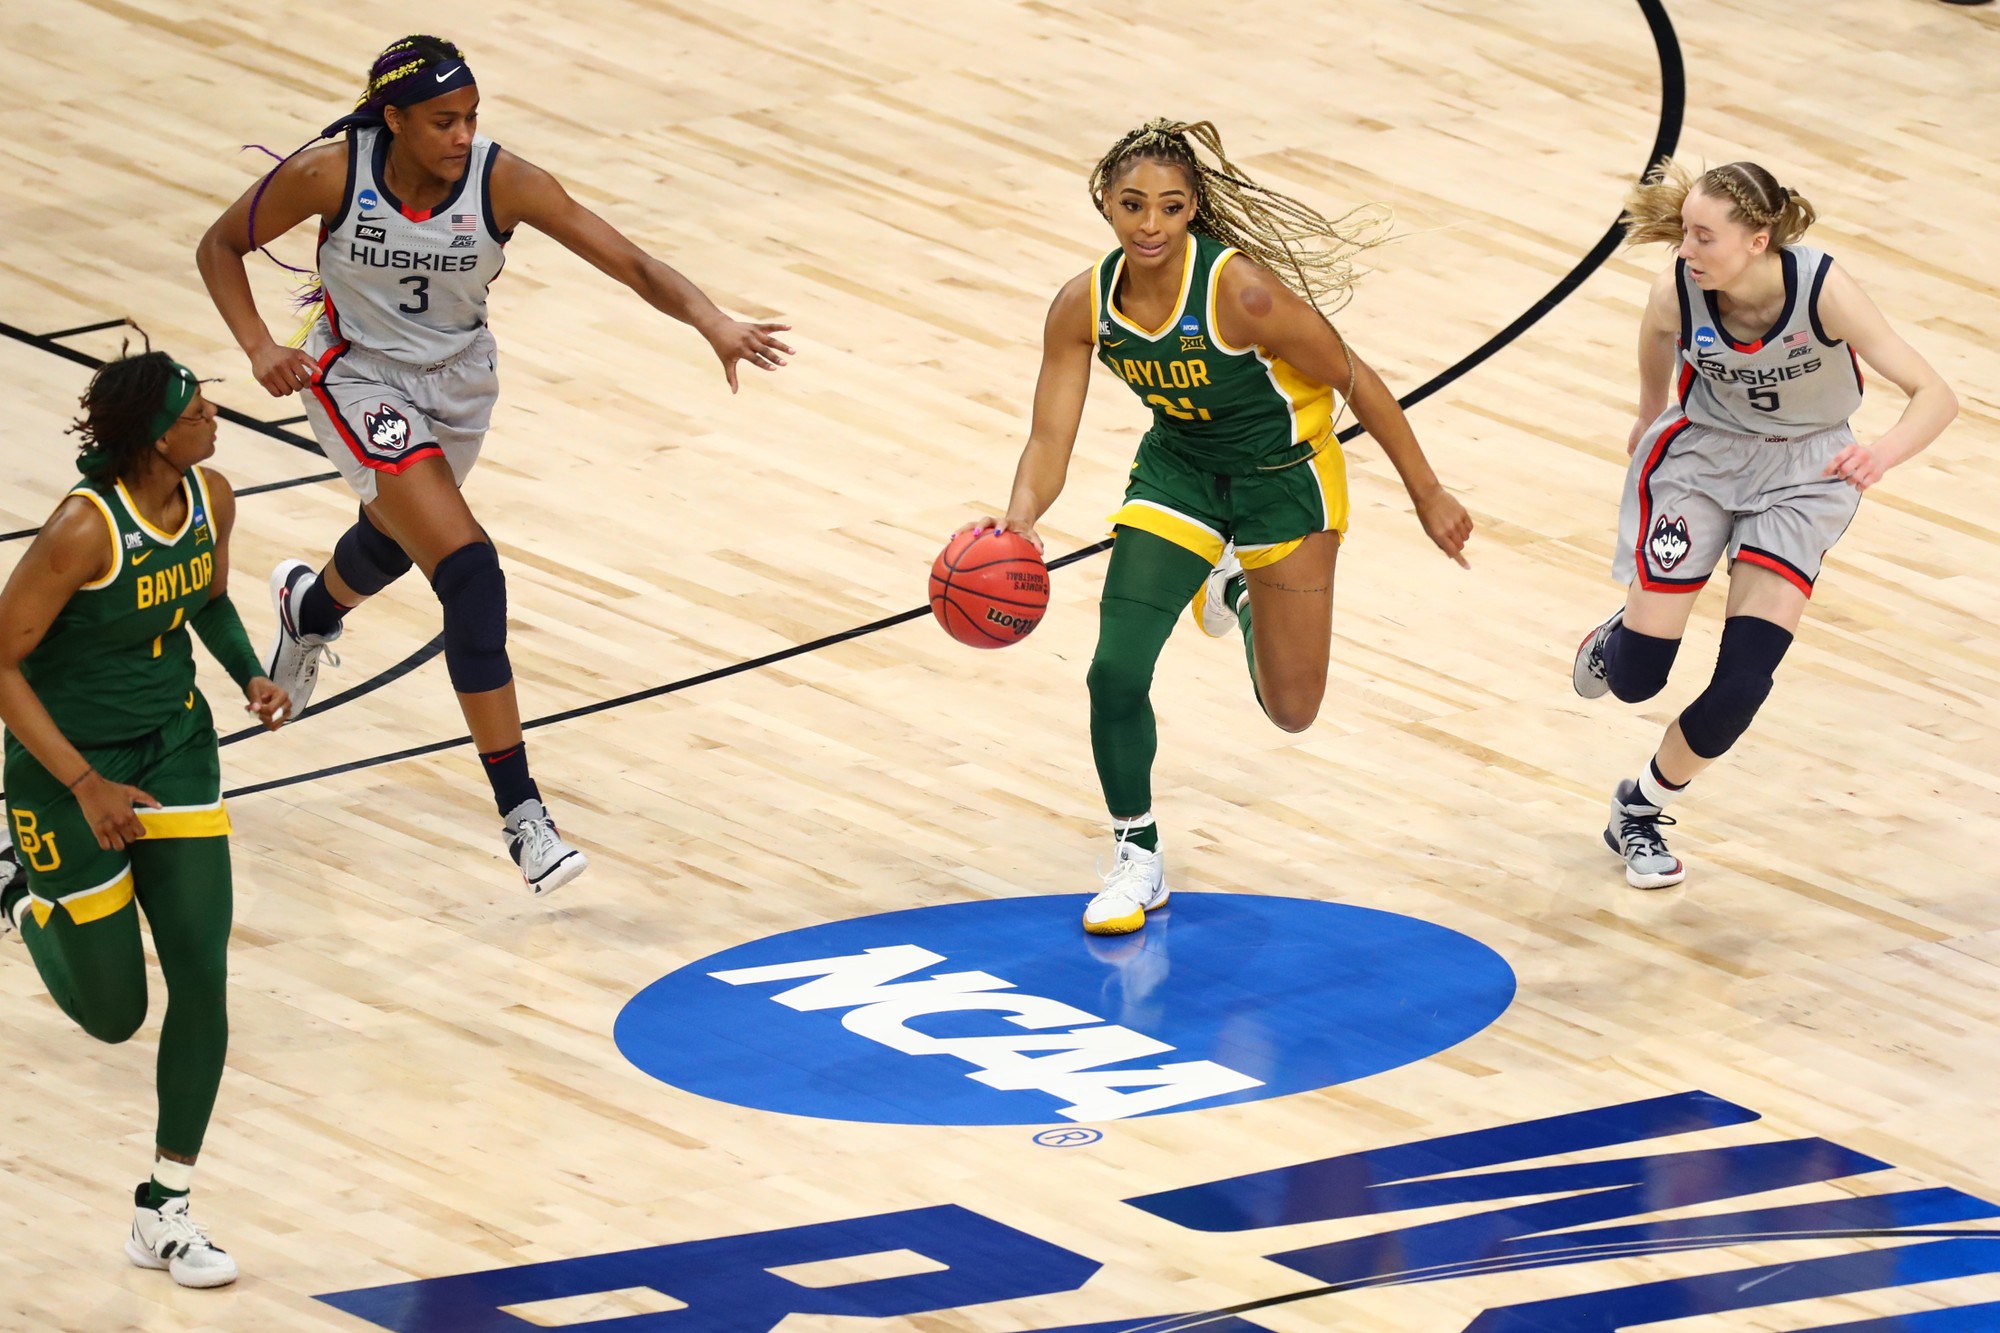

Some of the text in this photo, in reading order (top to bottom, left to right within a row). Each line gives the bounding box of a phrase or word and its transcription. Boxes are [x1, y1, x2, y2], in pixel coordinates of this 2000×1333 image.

[359, 197, 377, 206] NCAA
[358, 227, 383, 239] BLM
[350, 243, 478, 272] HUSKIES
[399, 275, 429, 314] 3
[1697, 335, 1714, 343] NCAA
[1146, 394, 1213, 421] 21
[1747, 384, 1780, 412] 5
[137, 551, 213, 609] BAYLOR
[152, 607, 185, 658] 1
[11, 808, 62, 873] BU
[705, 943, 1267, 1123] NCAA
